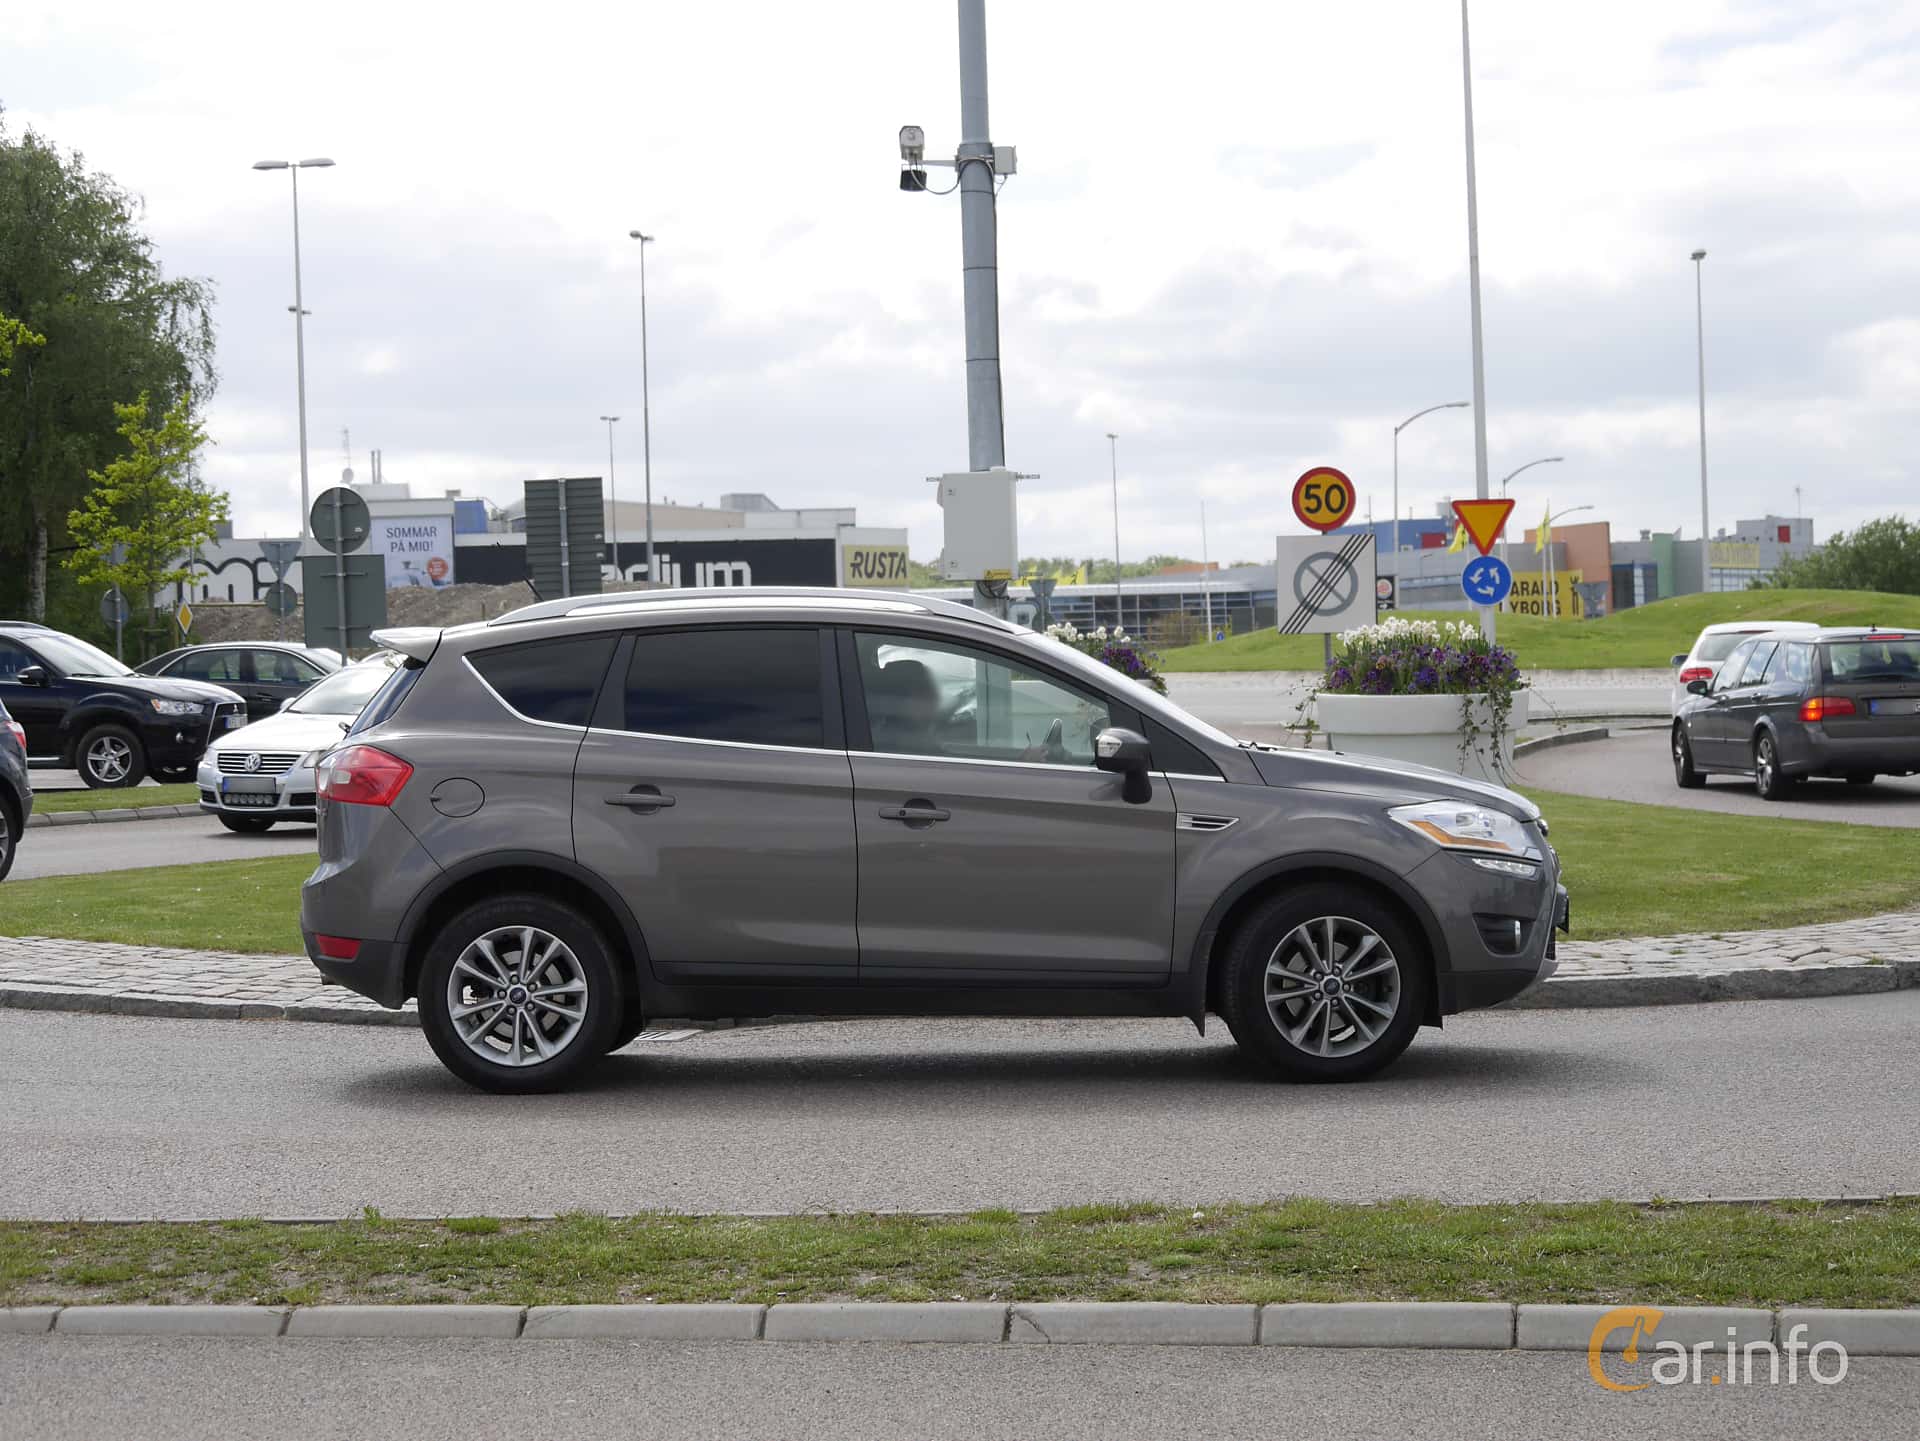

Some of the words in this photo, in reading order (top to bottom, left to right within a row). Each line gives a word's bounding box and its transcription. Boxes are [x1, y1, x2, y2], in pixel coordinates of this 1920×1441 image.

[1303, 483, 1347, 514] 50
[386, 526, 437, 538] SOMMAR
[409, 541, 433, 552] MIO!
[850, 551, 907, 579] RUSTA
[1510, 581, 1559, 596] ARALD
